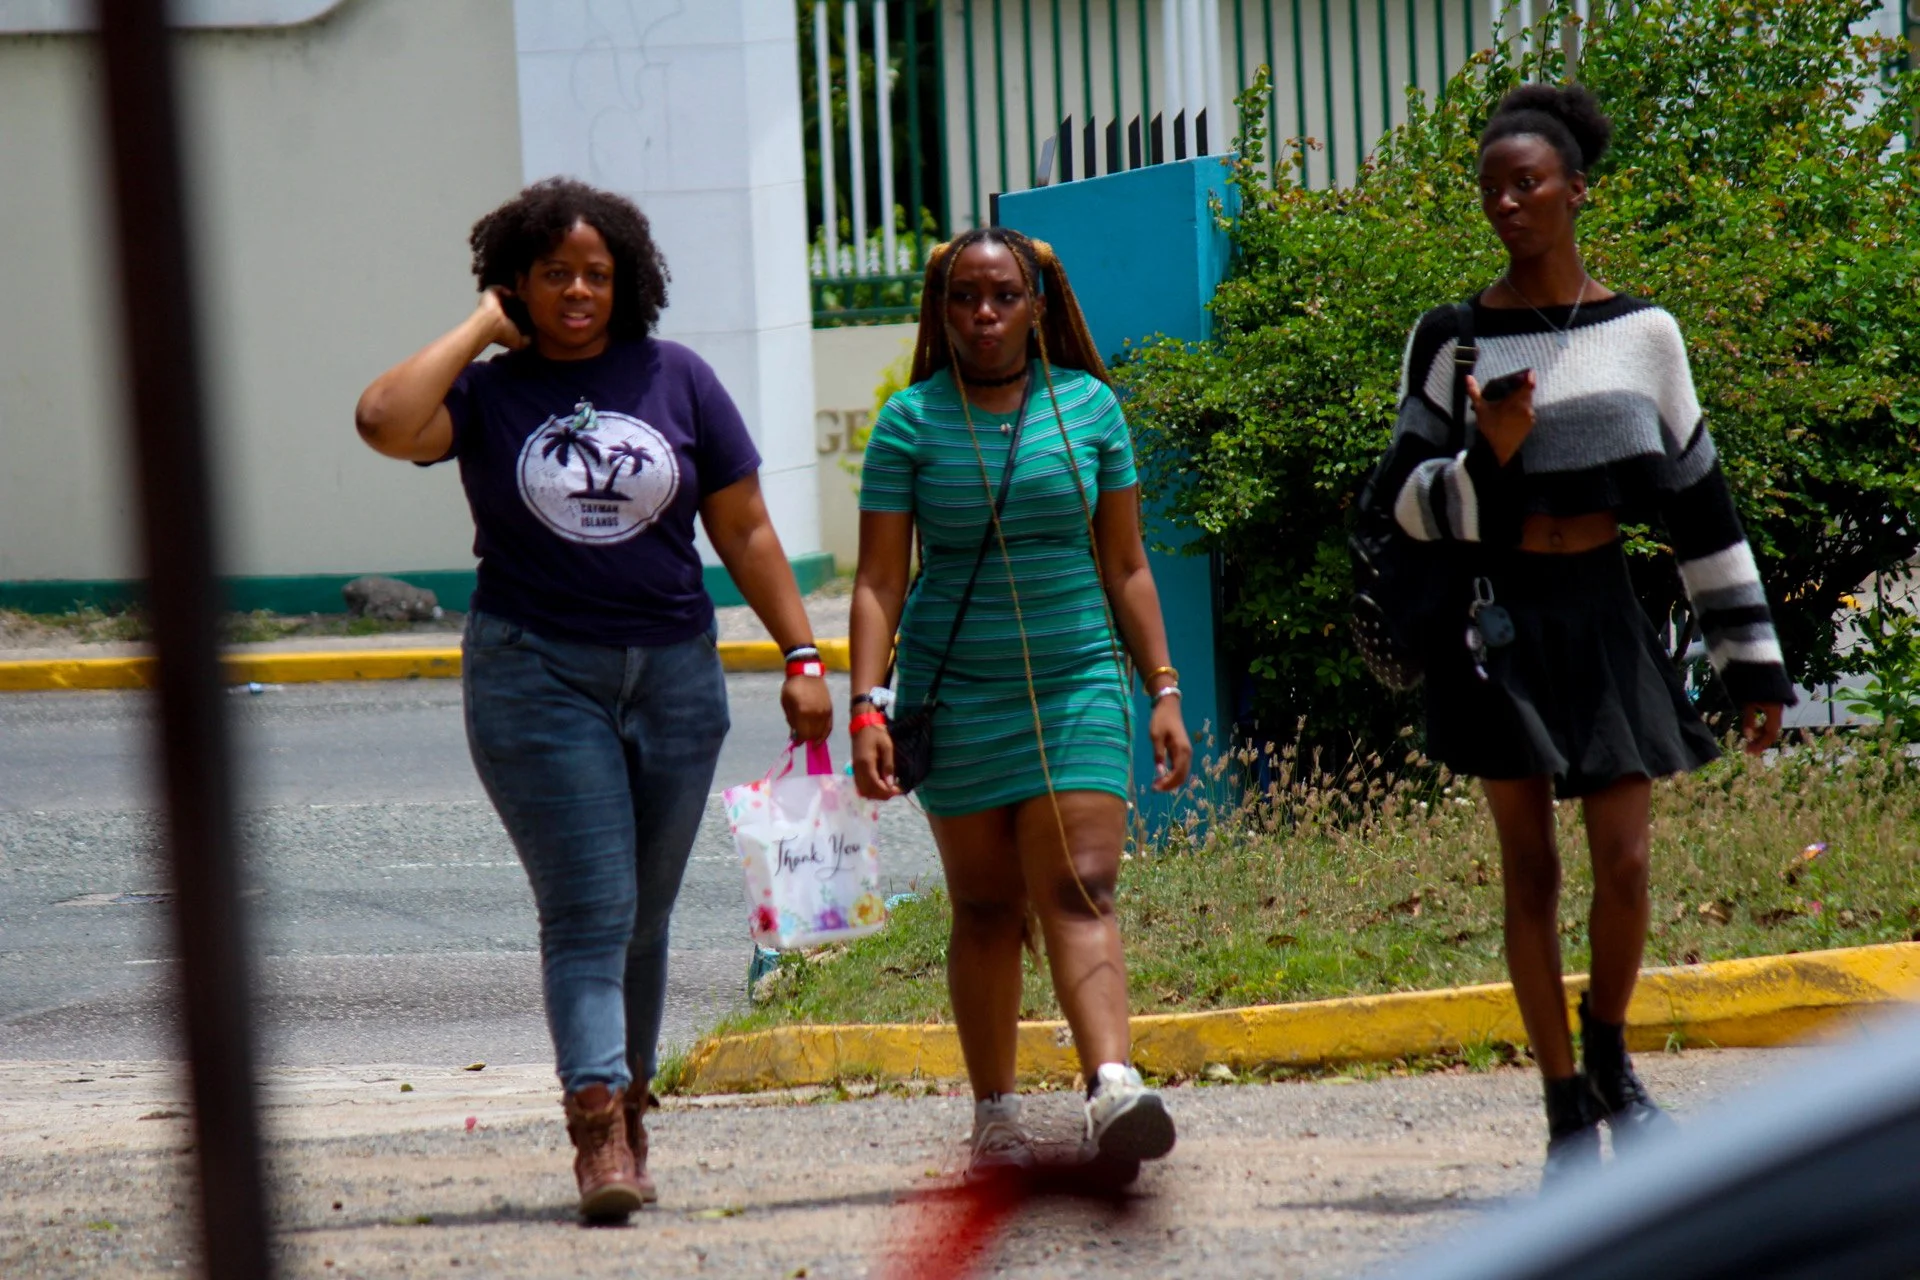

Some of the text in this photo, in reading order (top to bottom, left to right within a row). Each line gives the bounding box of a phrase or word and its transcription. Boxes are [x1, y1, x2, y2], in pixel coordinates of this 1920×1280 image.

[581, 503, 619, 513] CAYMAN
[581, 516, 619, 528] ISLANDS
[772, 833, 861, 880] Thank You
